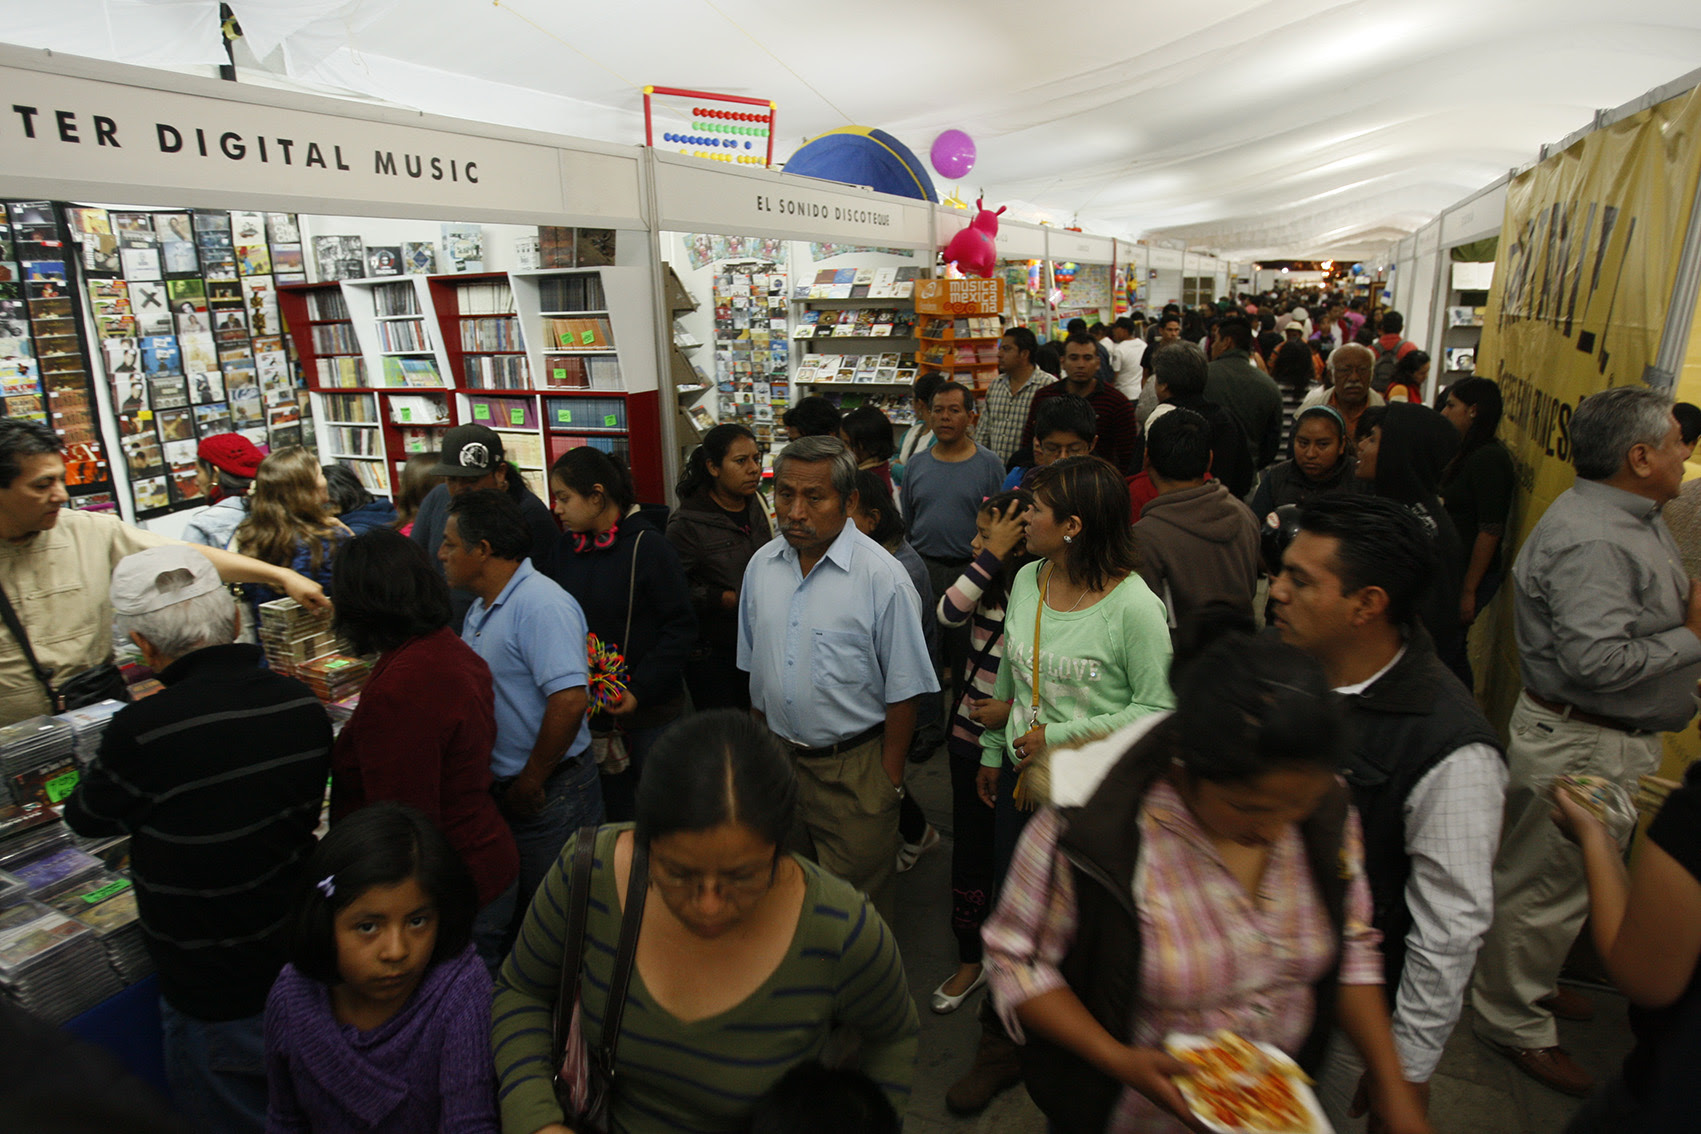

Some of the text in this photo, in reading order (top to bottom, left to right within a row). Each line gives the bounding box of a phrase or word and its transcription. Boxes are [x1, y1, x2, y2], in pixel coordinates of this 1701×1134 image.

[12, 104, 479, 184] TER DIGITAL MUSIC
[757, 195, 771, 212] EL
[779, 198, 828, 219] SONIDO
